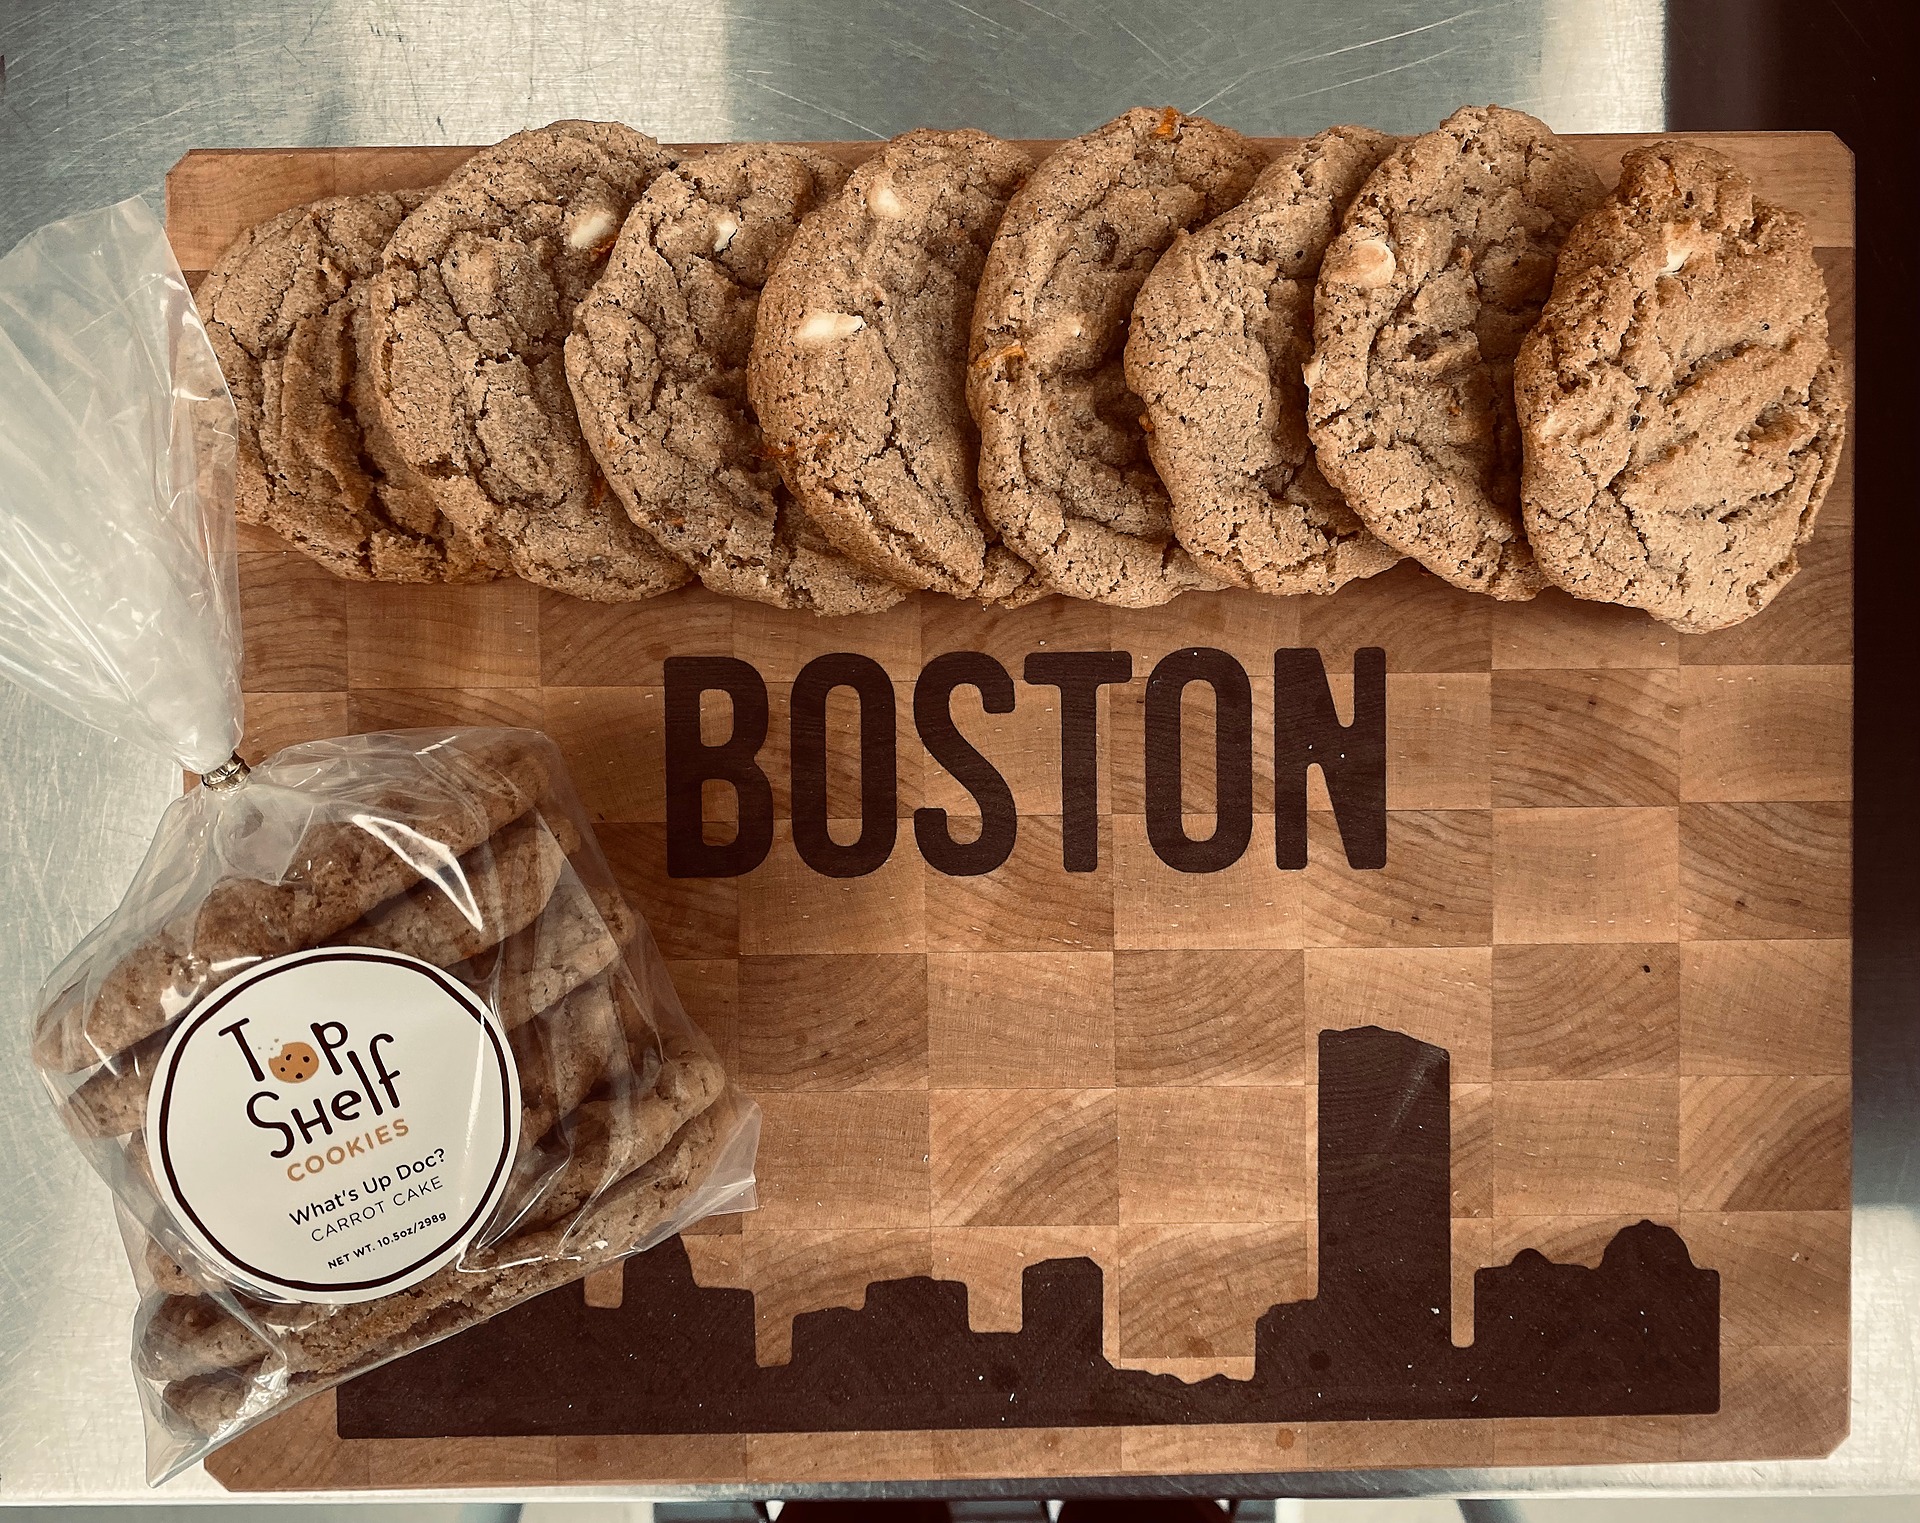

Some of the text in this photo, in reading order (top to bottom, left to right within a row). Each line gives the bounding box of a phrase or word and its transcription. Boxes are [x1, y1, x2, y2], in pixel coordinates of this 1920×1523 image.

[664, 646, 1387, 878] BOSTON
[287, 1119, 409, 1182] COOKIES
[289, 1148, 445, 1226] What's Up Doc?
[311, 1176, 443, 1242] CARROT CAKE
[327, 1211, 447, 1269] NET WT. 10.5oz/298g
